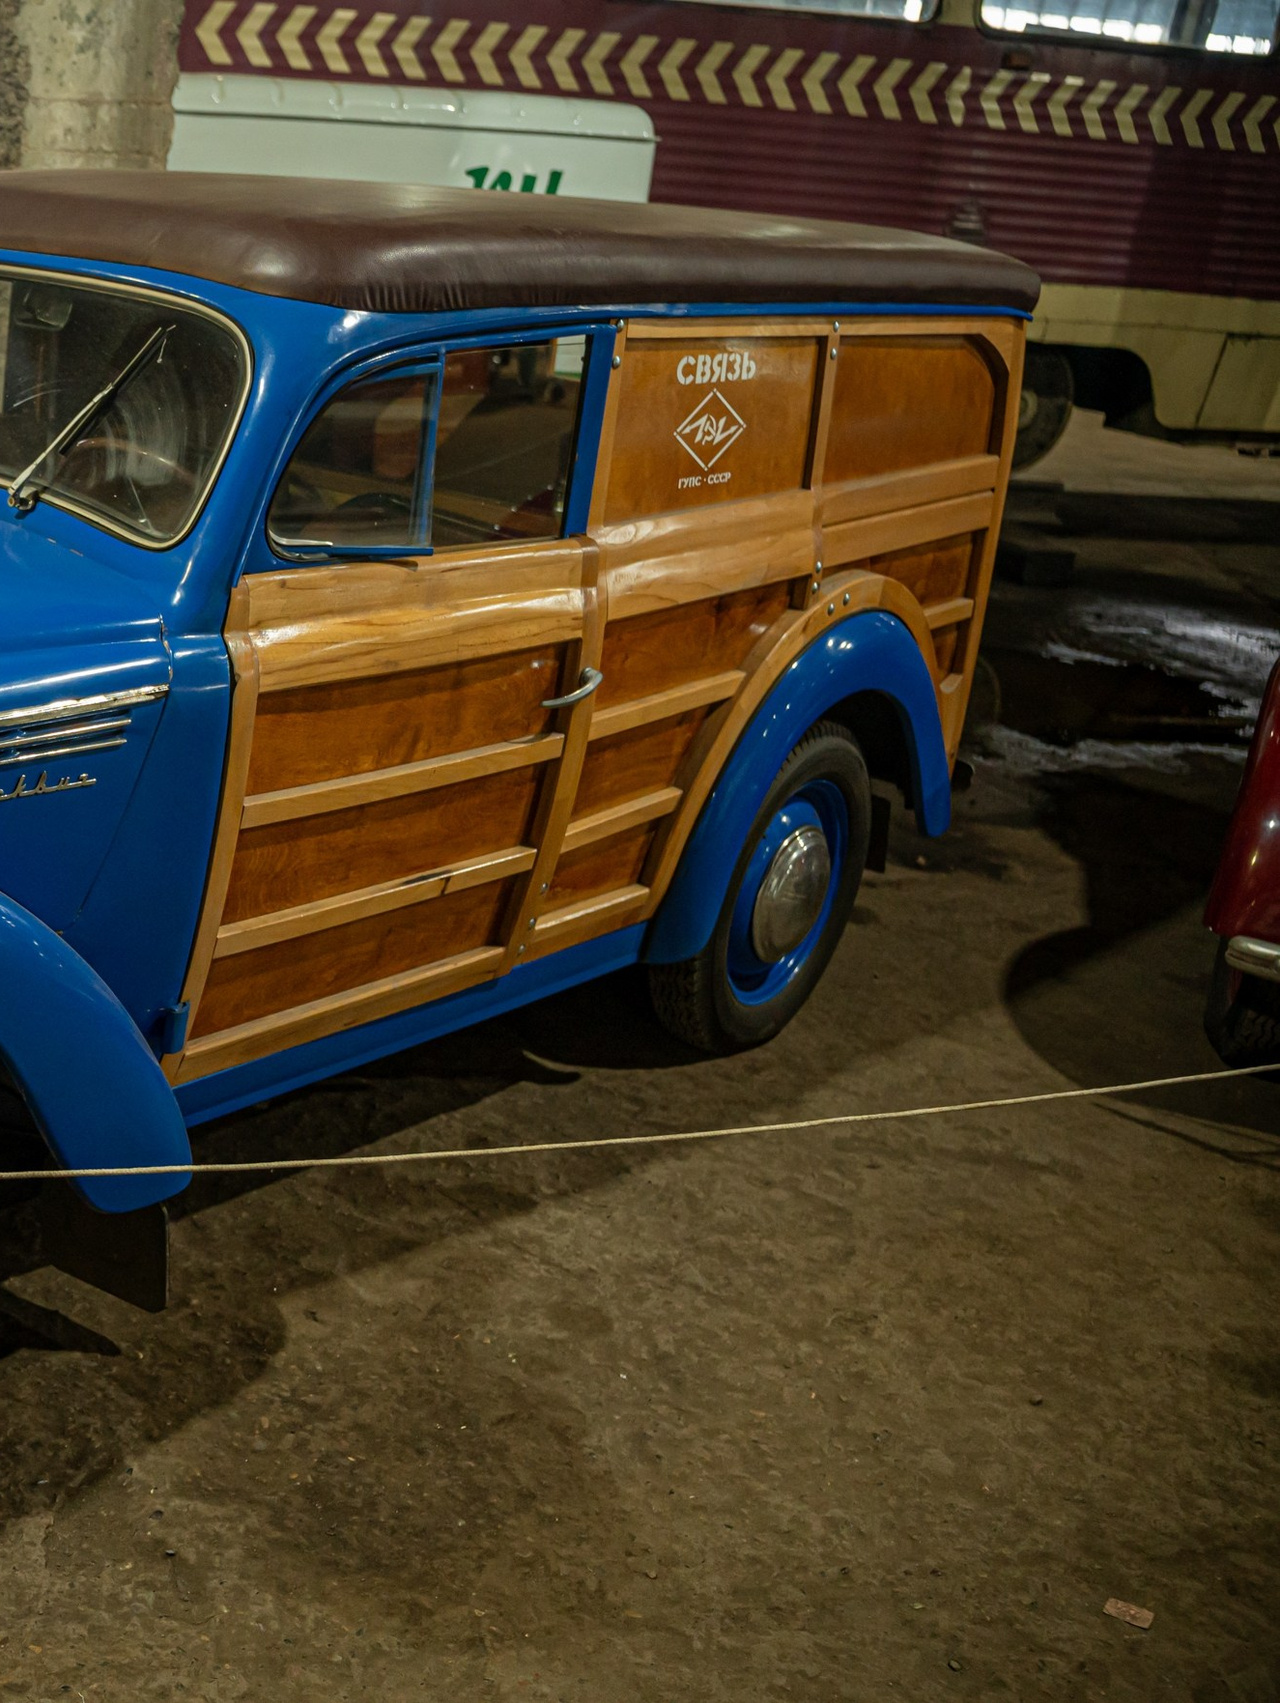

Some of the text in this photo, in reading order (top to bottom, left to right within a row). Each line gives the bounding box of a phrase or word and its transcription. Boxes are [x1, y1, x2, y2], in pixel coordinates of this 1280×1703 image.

[676, 351, 757, 385] СВЯЗЬ
[677, 471, 732, 489] ГУПС СССР
